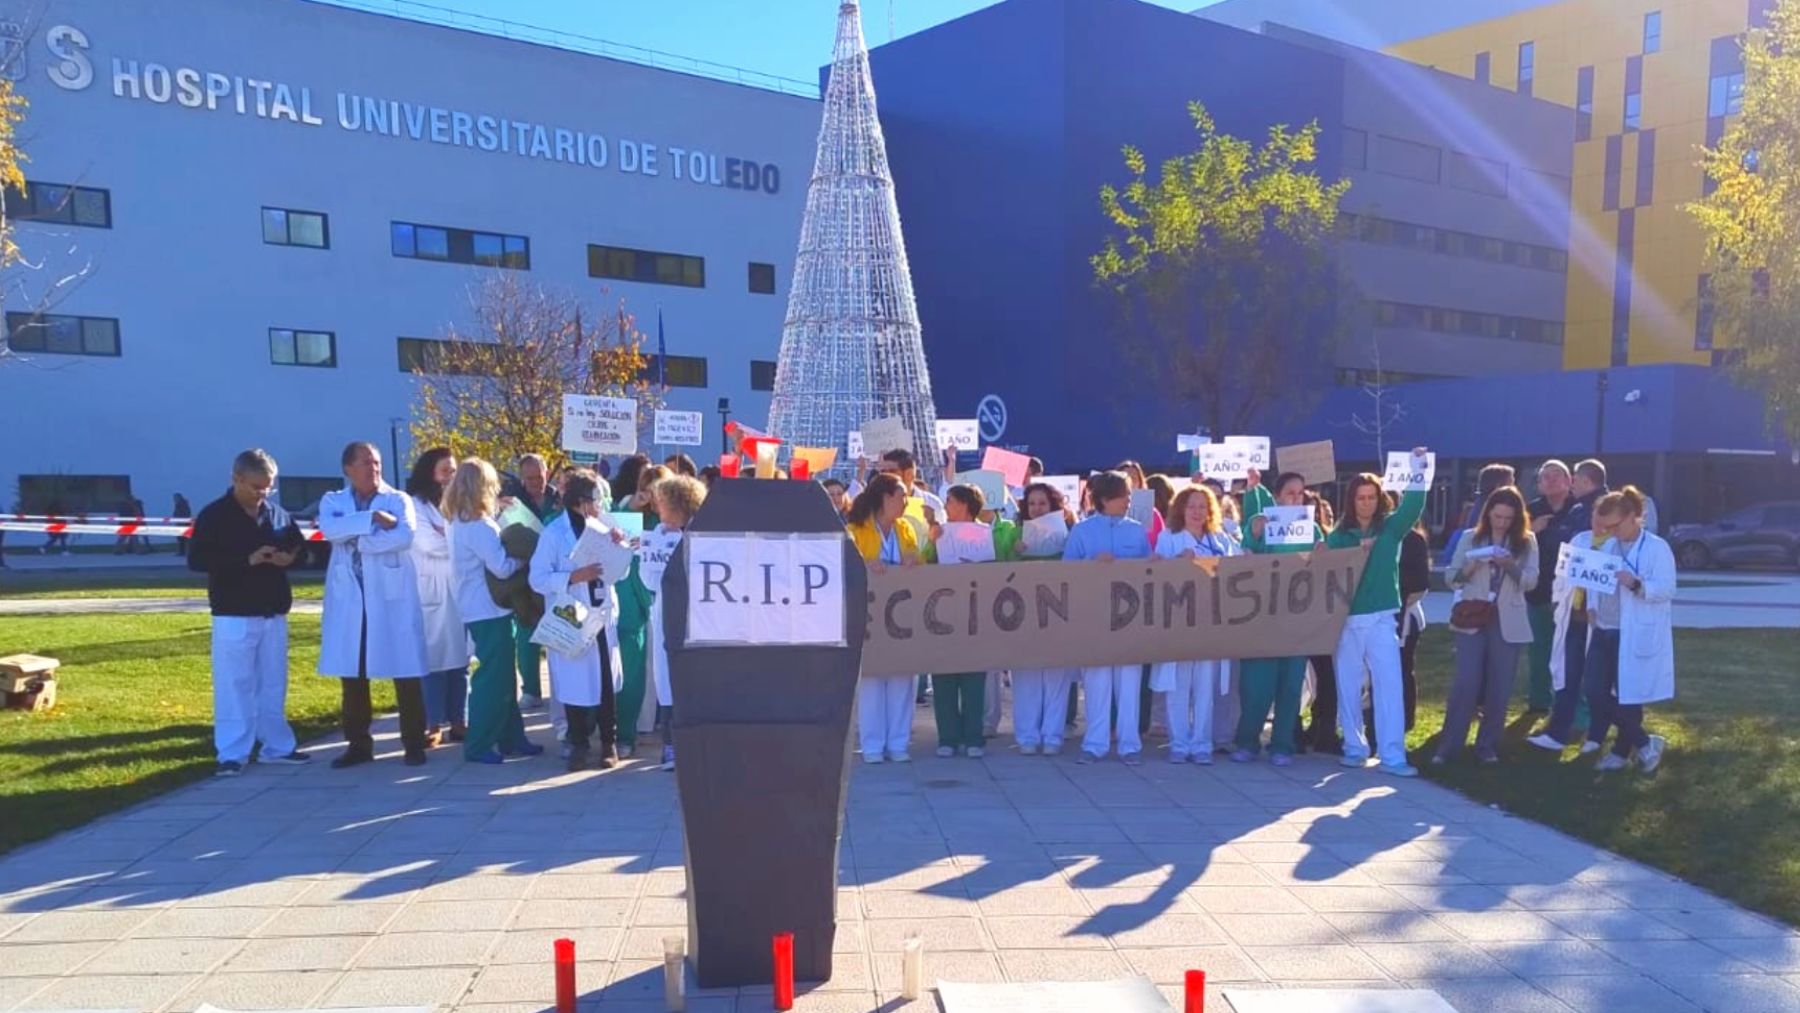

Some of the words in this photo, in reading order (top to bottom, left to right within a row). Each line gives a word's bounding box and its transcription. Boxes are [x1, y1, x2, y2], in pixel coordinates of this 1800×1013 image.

[112, 58, 323, 126] HOSPITAL
[337, 93, 608, 168] UNIVERSITARIO
[620, 138, 659, 176] DE
[669, 147, 781, 195] TOLEDO
[698, 560, 830, 606] R.I.P
